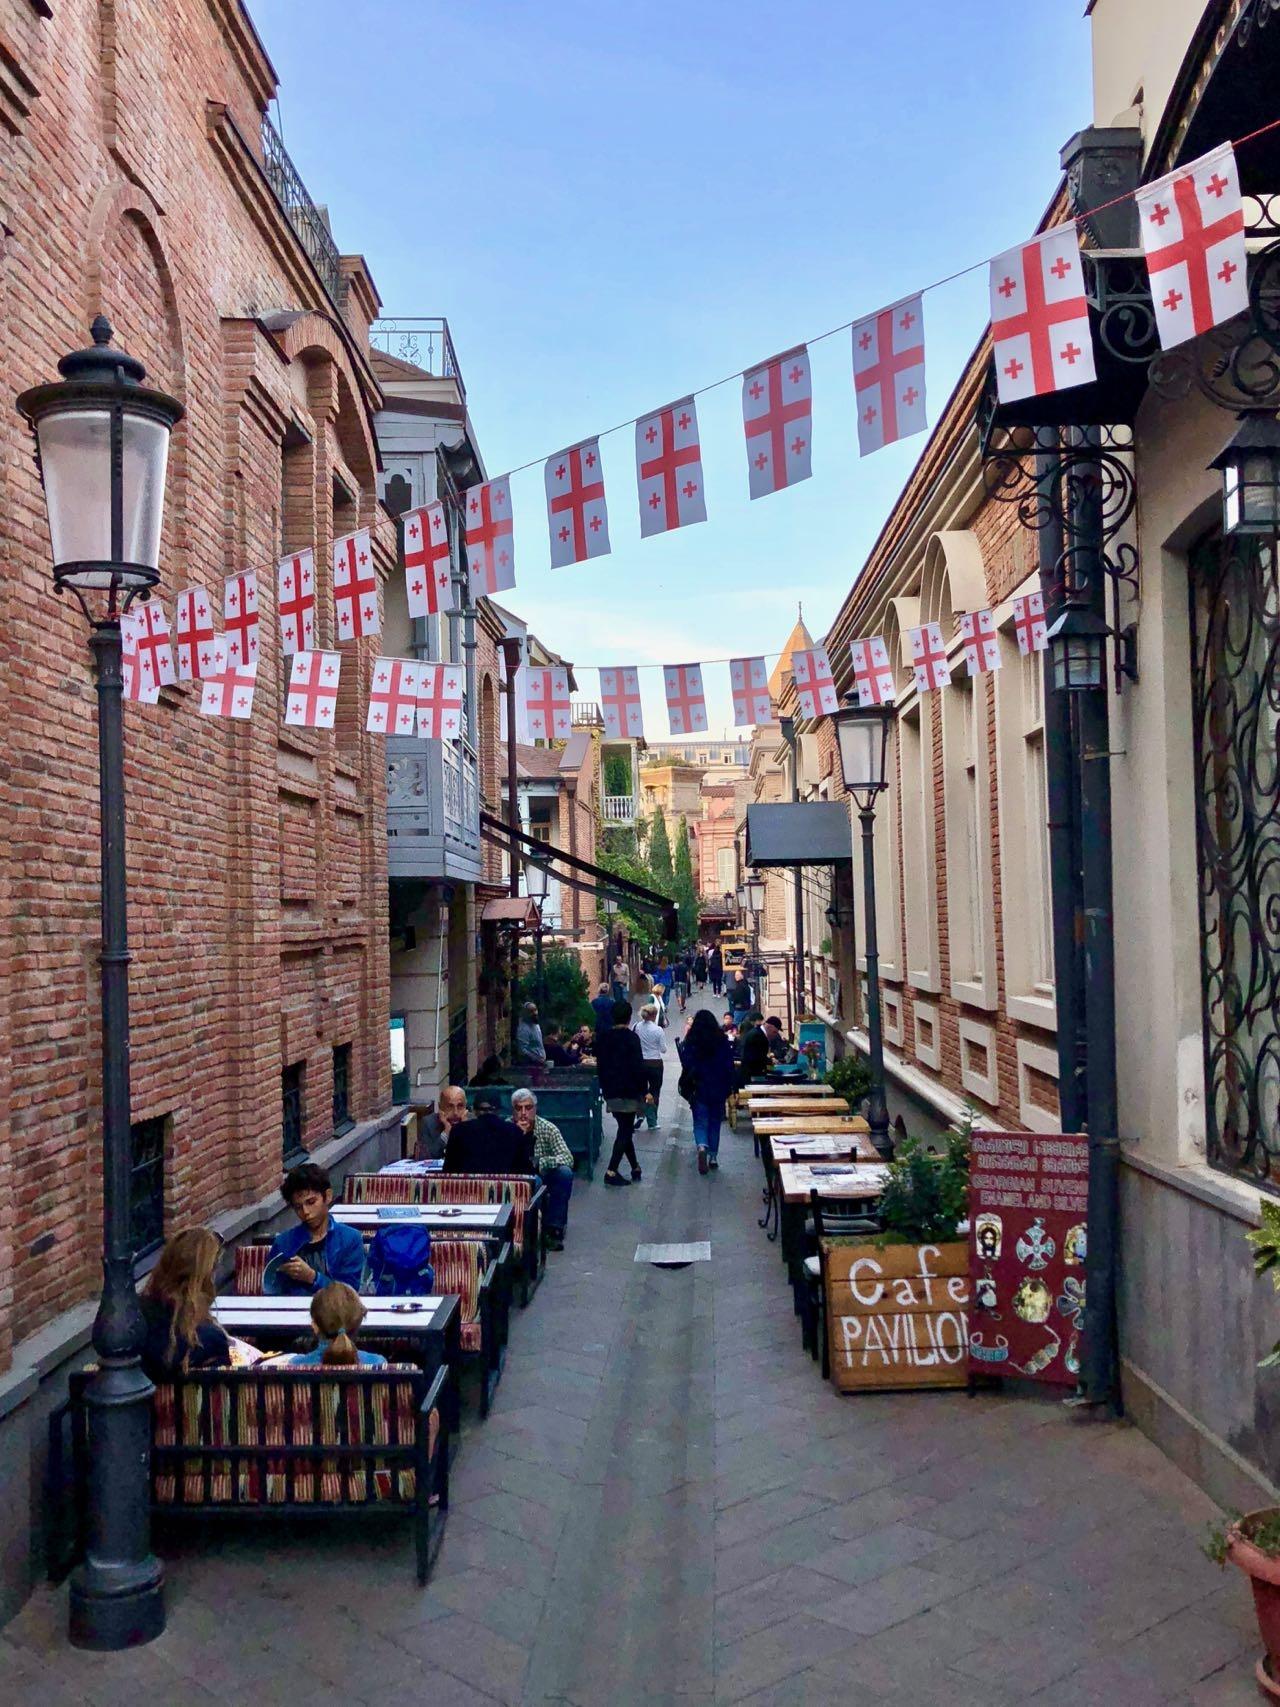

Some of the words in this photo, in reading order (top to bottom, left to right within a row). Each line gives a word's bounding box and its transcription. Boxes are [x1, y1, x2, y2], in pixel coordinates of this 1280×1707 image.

[971, 1174, 1036, 1192] GEORGIAN
[980, 1190, 1026, 1207] ENAMEL
[1026, 1193, 1052, 1209] AND
[849, 1245, 969, 1306] Cafe
